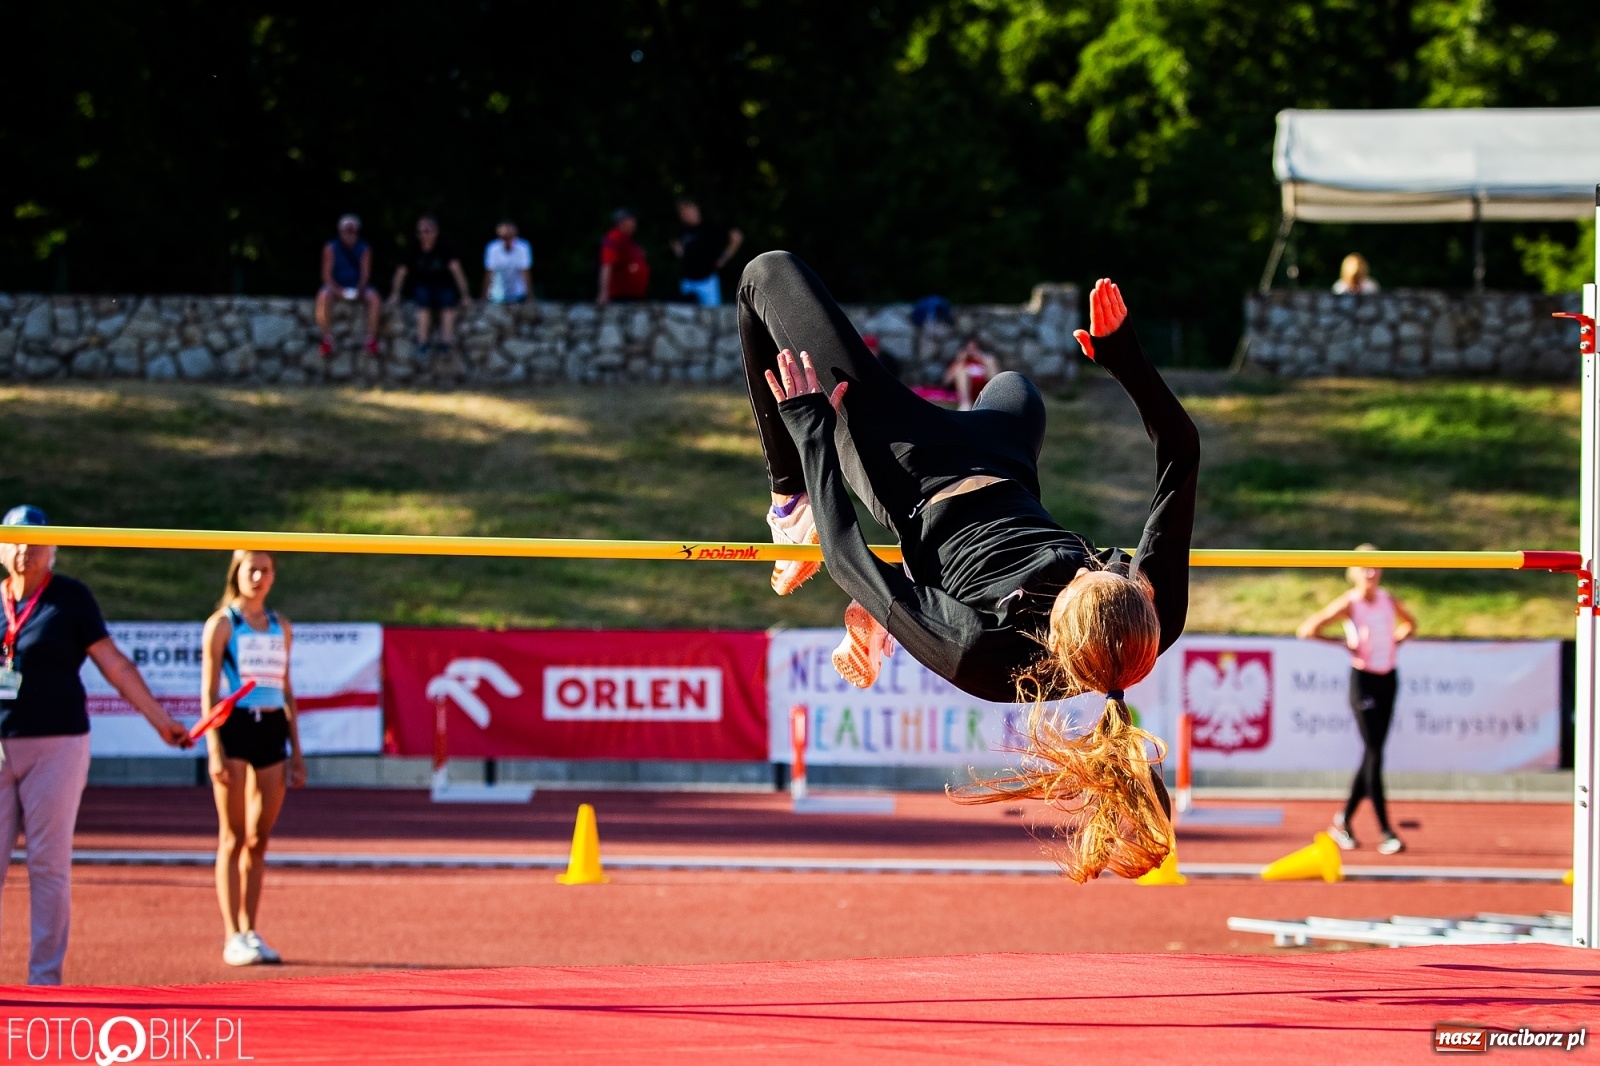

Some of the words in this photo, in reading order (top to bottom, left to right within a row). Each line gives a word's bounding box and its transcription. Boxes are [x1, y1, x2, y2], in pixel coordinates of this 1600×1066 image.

[697, 545, 759, 560] polanik
[557, 677, 707, 710] ORLEN
[813, 704, 987, 754] EALTHIER
[1414, 709, 1541, 742] Turystyki
